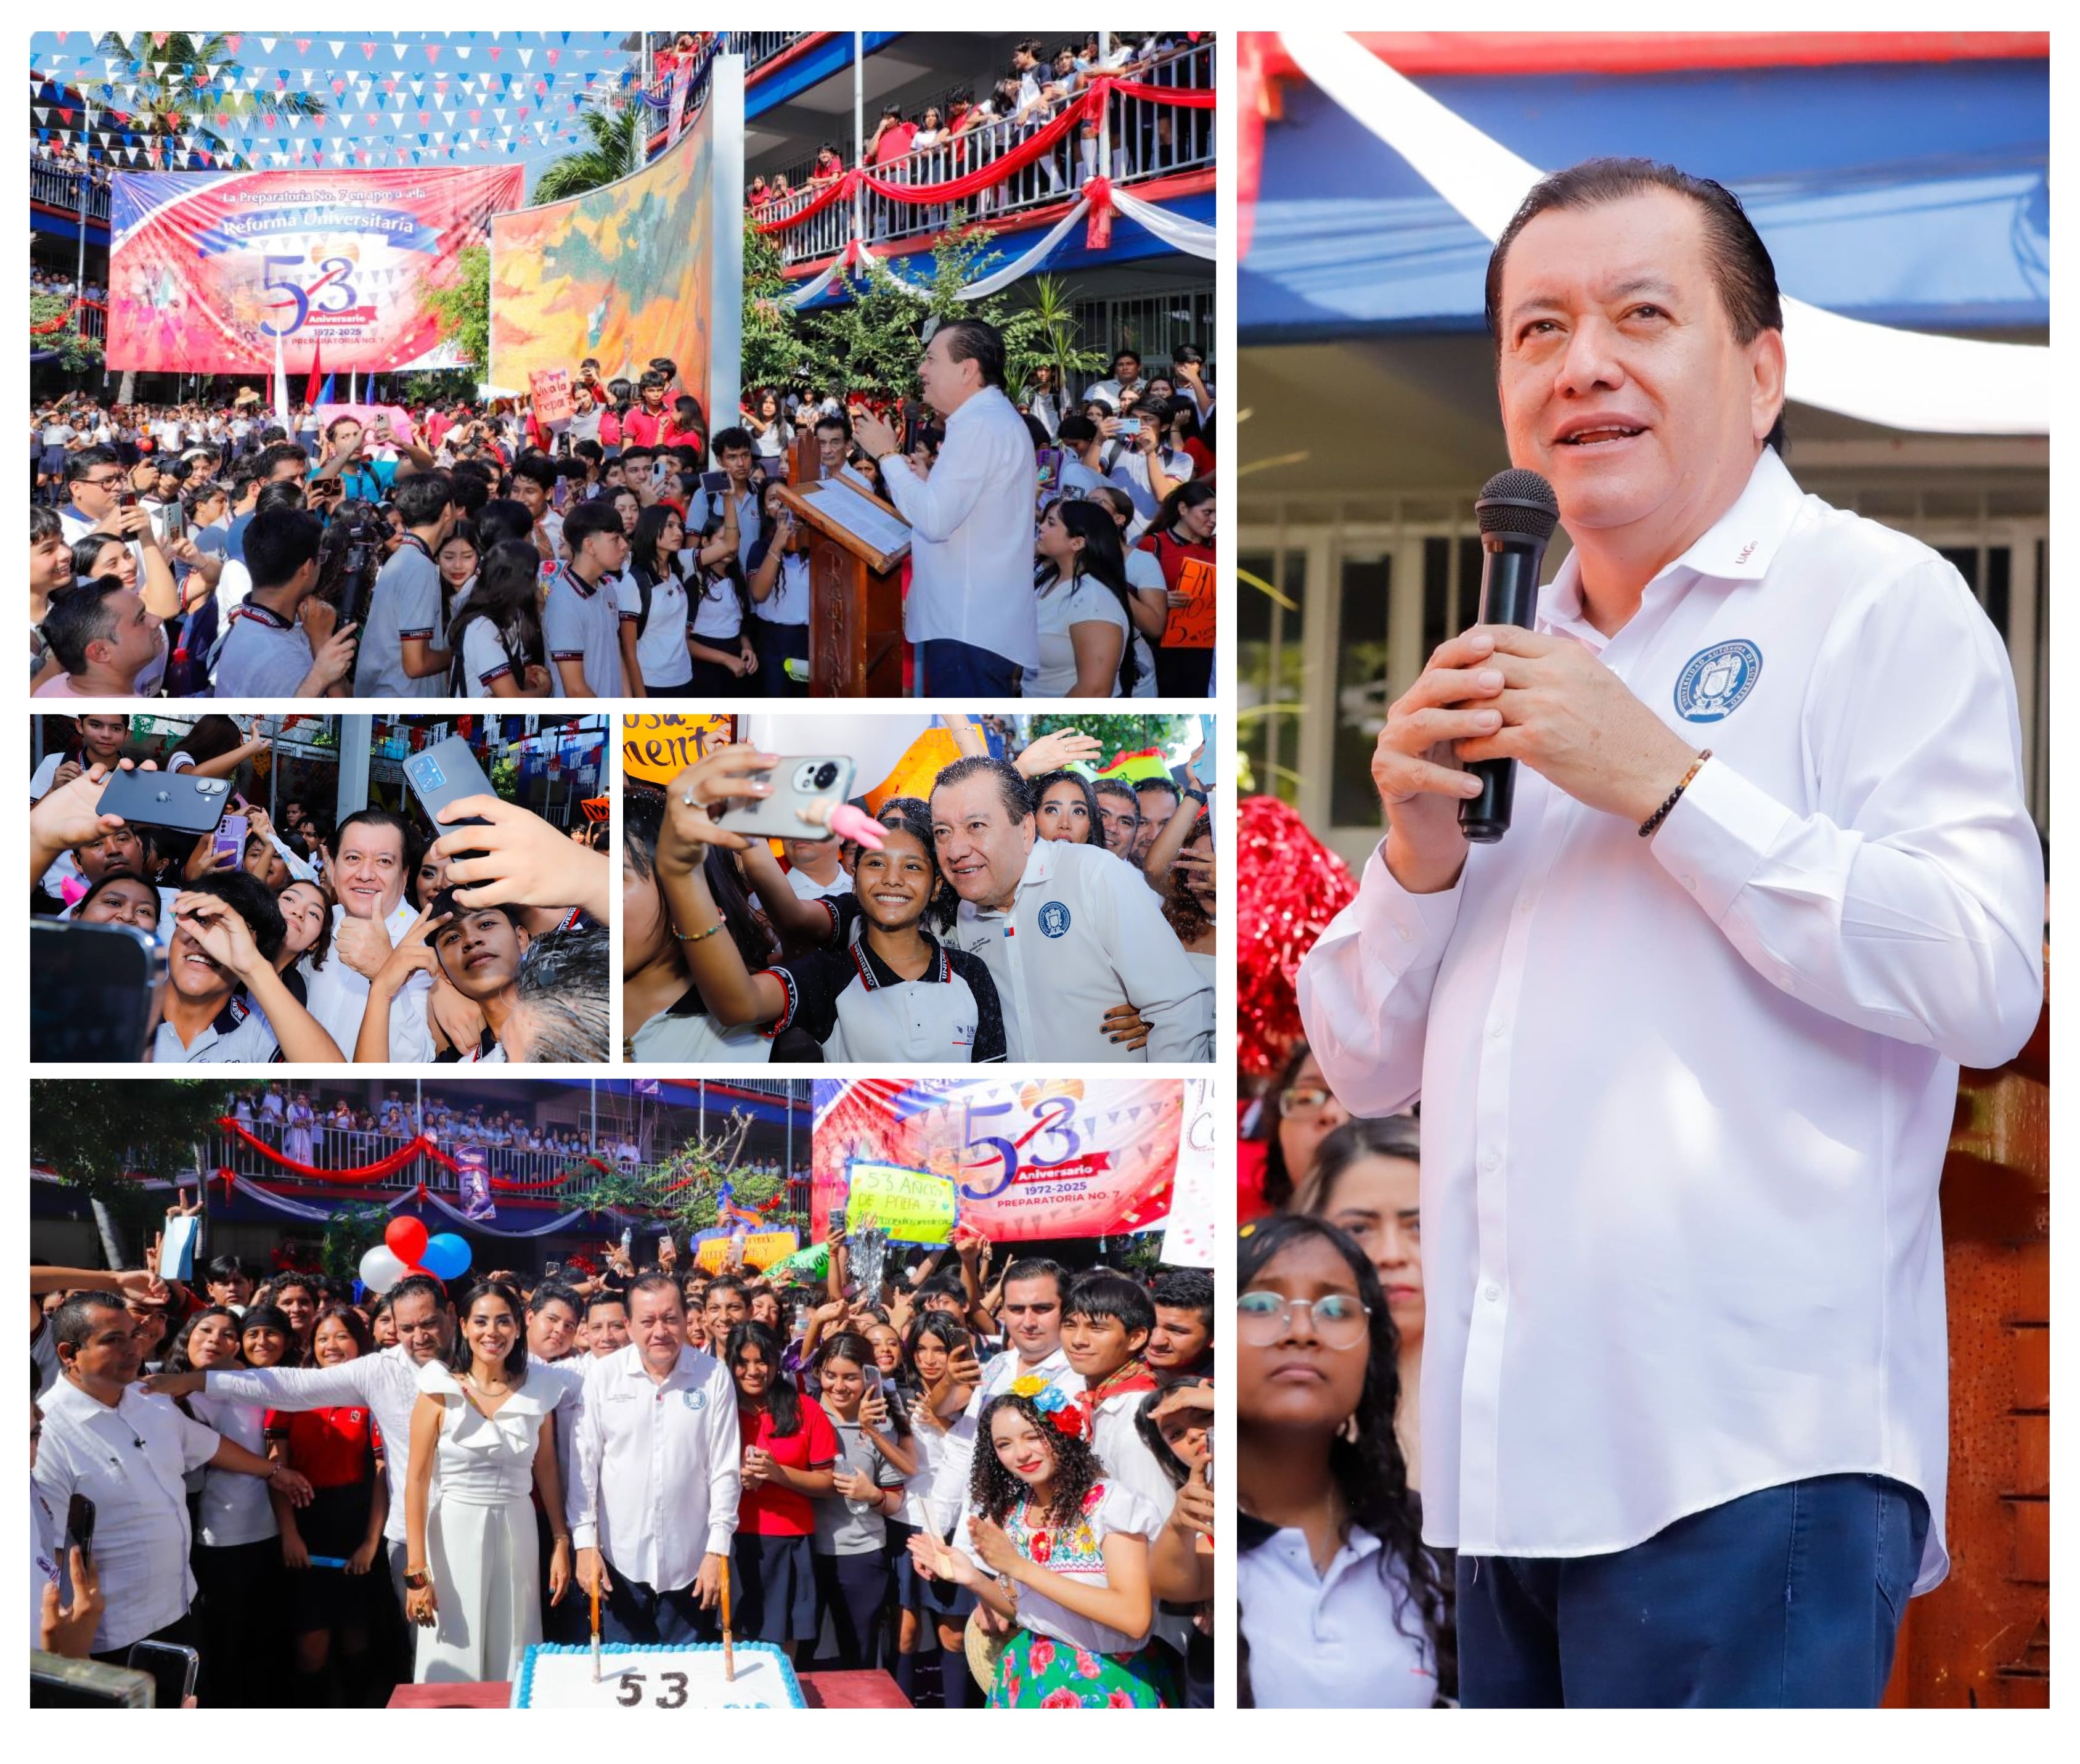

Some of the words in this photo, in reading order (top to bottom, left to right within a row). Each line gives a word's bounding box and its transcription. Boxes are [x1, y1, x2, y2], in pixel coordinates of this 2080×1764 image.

[222, 192, 236, 202] La
[240, 190, 312, 205] Preparatoria
[223, 215, 297, 235] Reforma
[303, 211, 414, 234] Universitaria
[259, 255, 358, 337] 53
[309, 314, 365, 324] Aniversario
[854, 942, 875, 986] GUERRERO
[961, 1096, 1080, 1200] 53
[1018, 1164, 1093, 1182] Aniversario
[997, 1193, 1085, 1208] PREPARATORIA
[1087, 1191, 1110, 1200] NO.
[1113, 1190, 1120, 1199] 7
[1025, 1182, 1087, 1196] 1972-2025
[616, 1672, 689, 1709] 53
